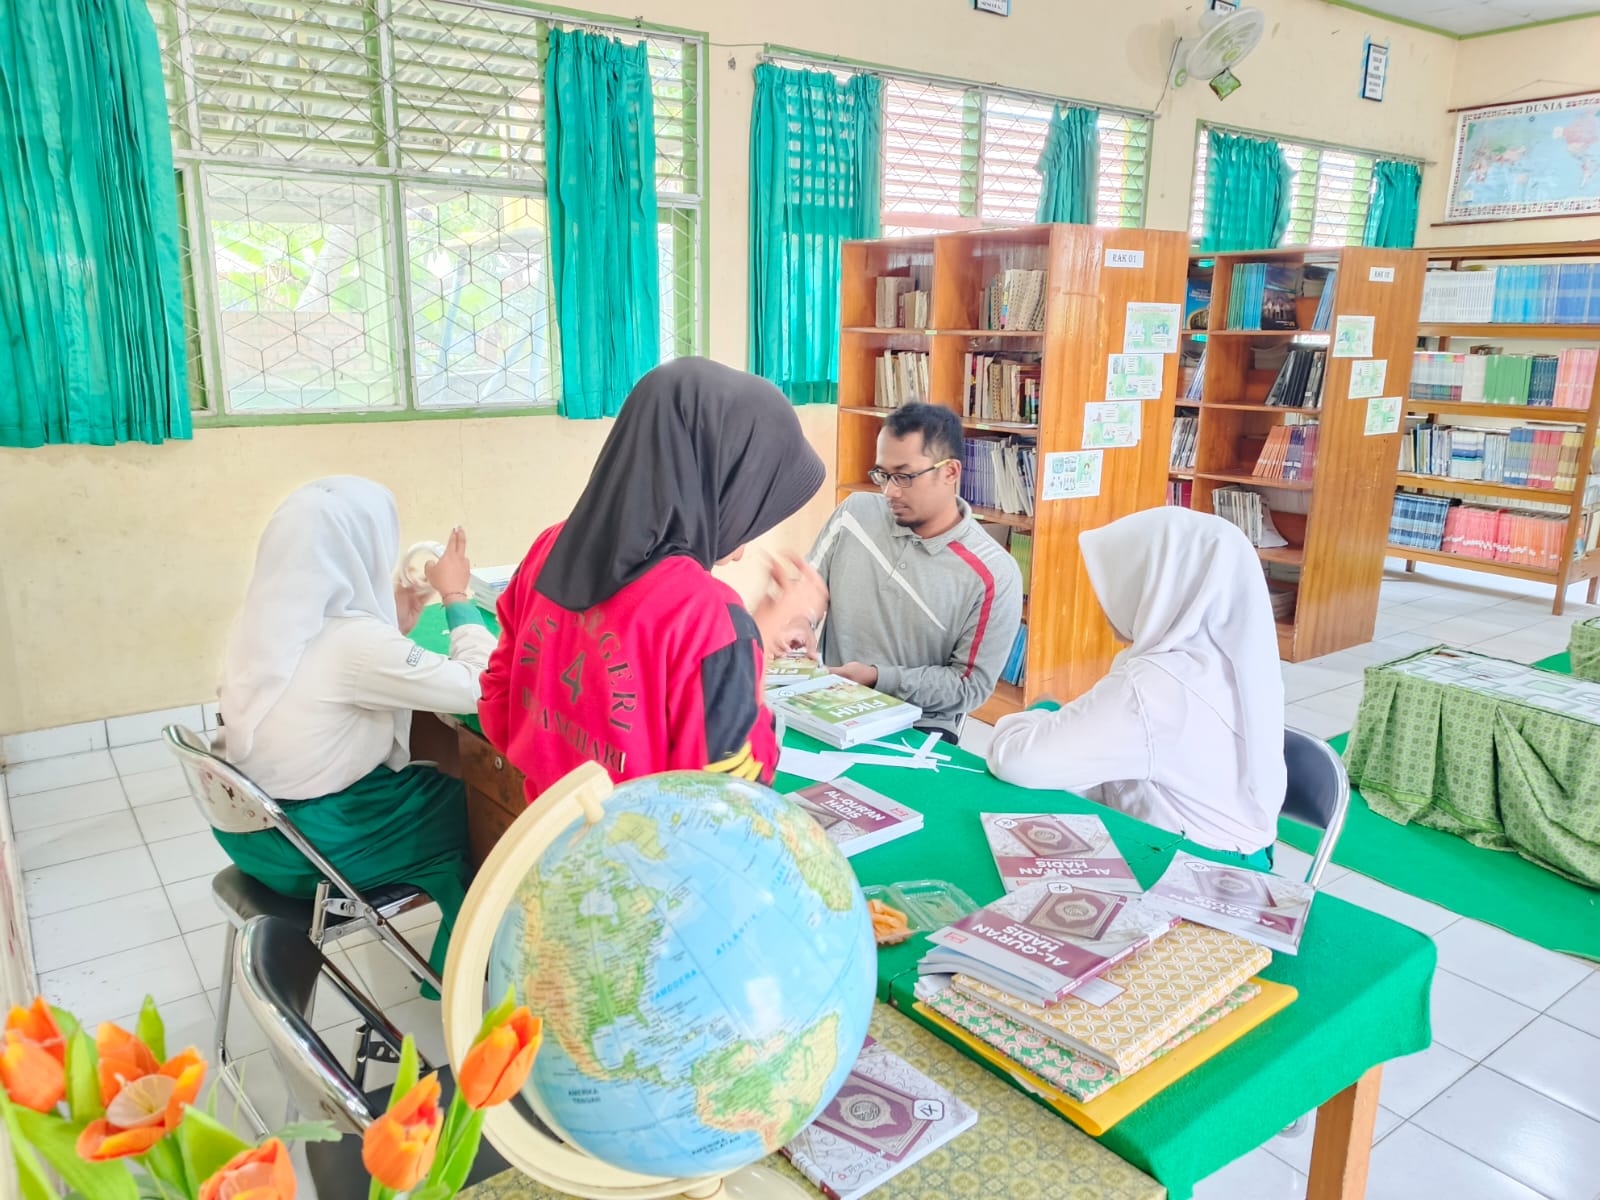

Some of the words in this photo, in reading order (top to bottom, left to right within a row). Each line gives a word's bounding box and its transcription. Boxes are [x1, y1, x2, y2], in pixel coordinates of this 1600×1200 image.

[1525, 102, 1563, 114] DUNIA
[1112, 254, 1126, 263] RAK
[560, 651, 586, 704] 4
[829, 699, 889, 718] FIKIH
[825, 799, 863, 820] HADIS
[1035, 861, 1088, 869] HADIS
[970, 923, 1069, 968] AL-QUR'AN
[1002, 926, 1060, 952] HADIS
